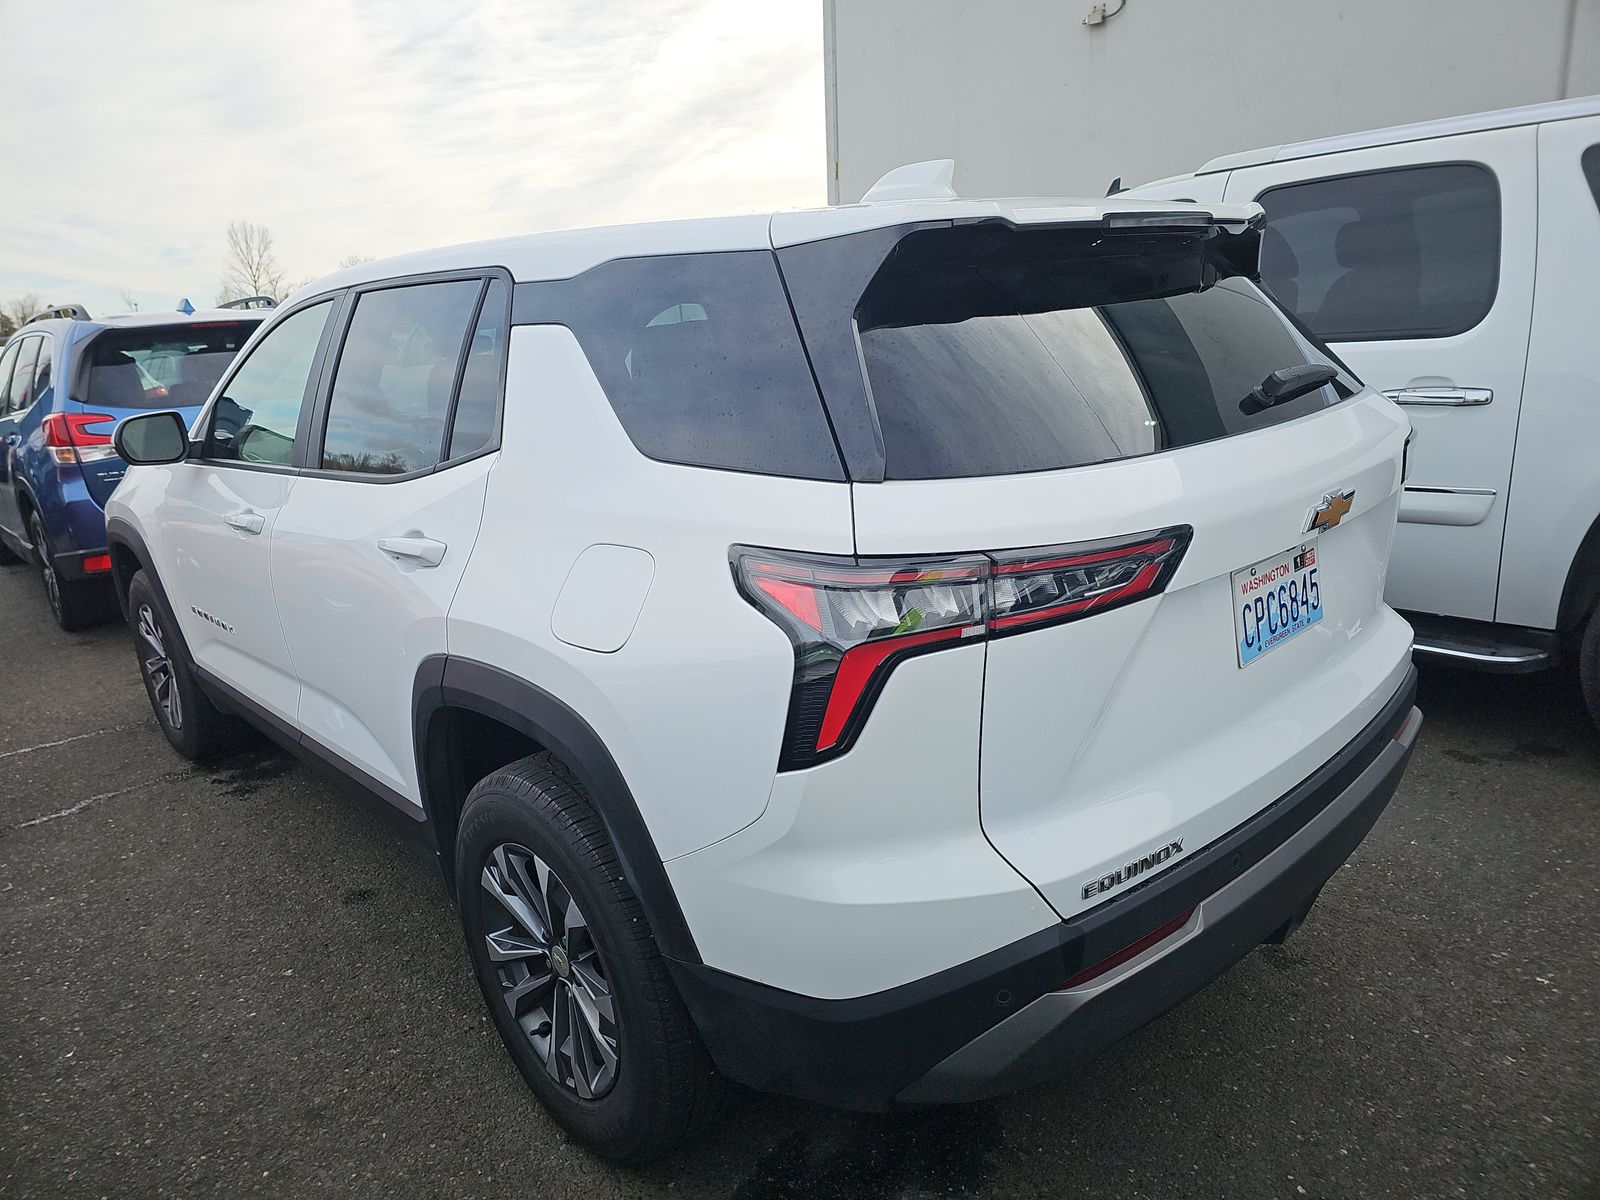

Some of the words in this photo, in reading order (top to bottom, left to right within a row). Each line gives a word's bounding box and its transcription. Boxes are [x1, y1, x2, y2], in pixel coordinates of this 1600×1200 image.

[1241, 563, 1290, 595] WASHINGTON
[1242, 567, 1320, 648] CPC6845
[1264, 629, 1291, 648] EVERGREEN
[1292, 620, 1305, 632] STATE
[1081, 835, 1185, 901] EQUINOX
